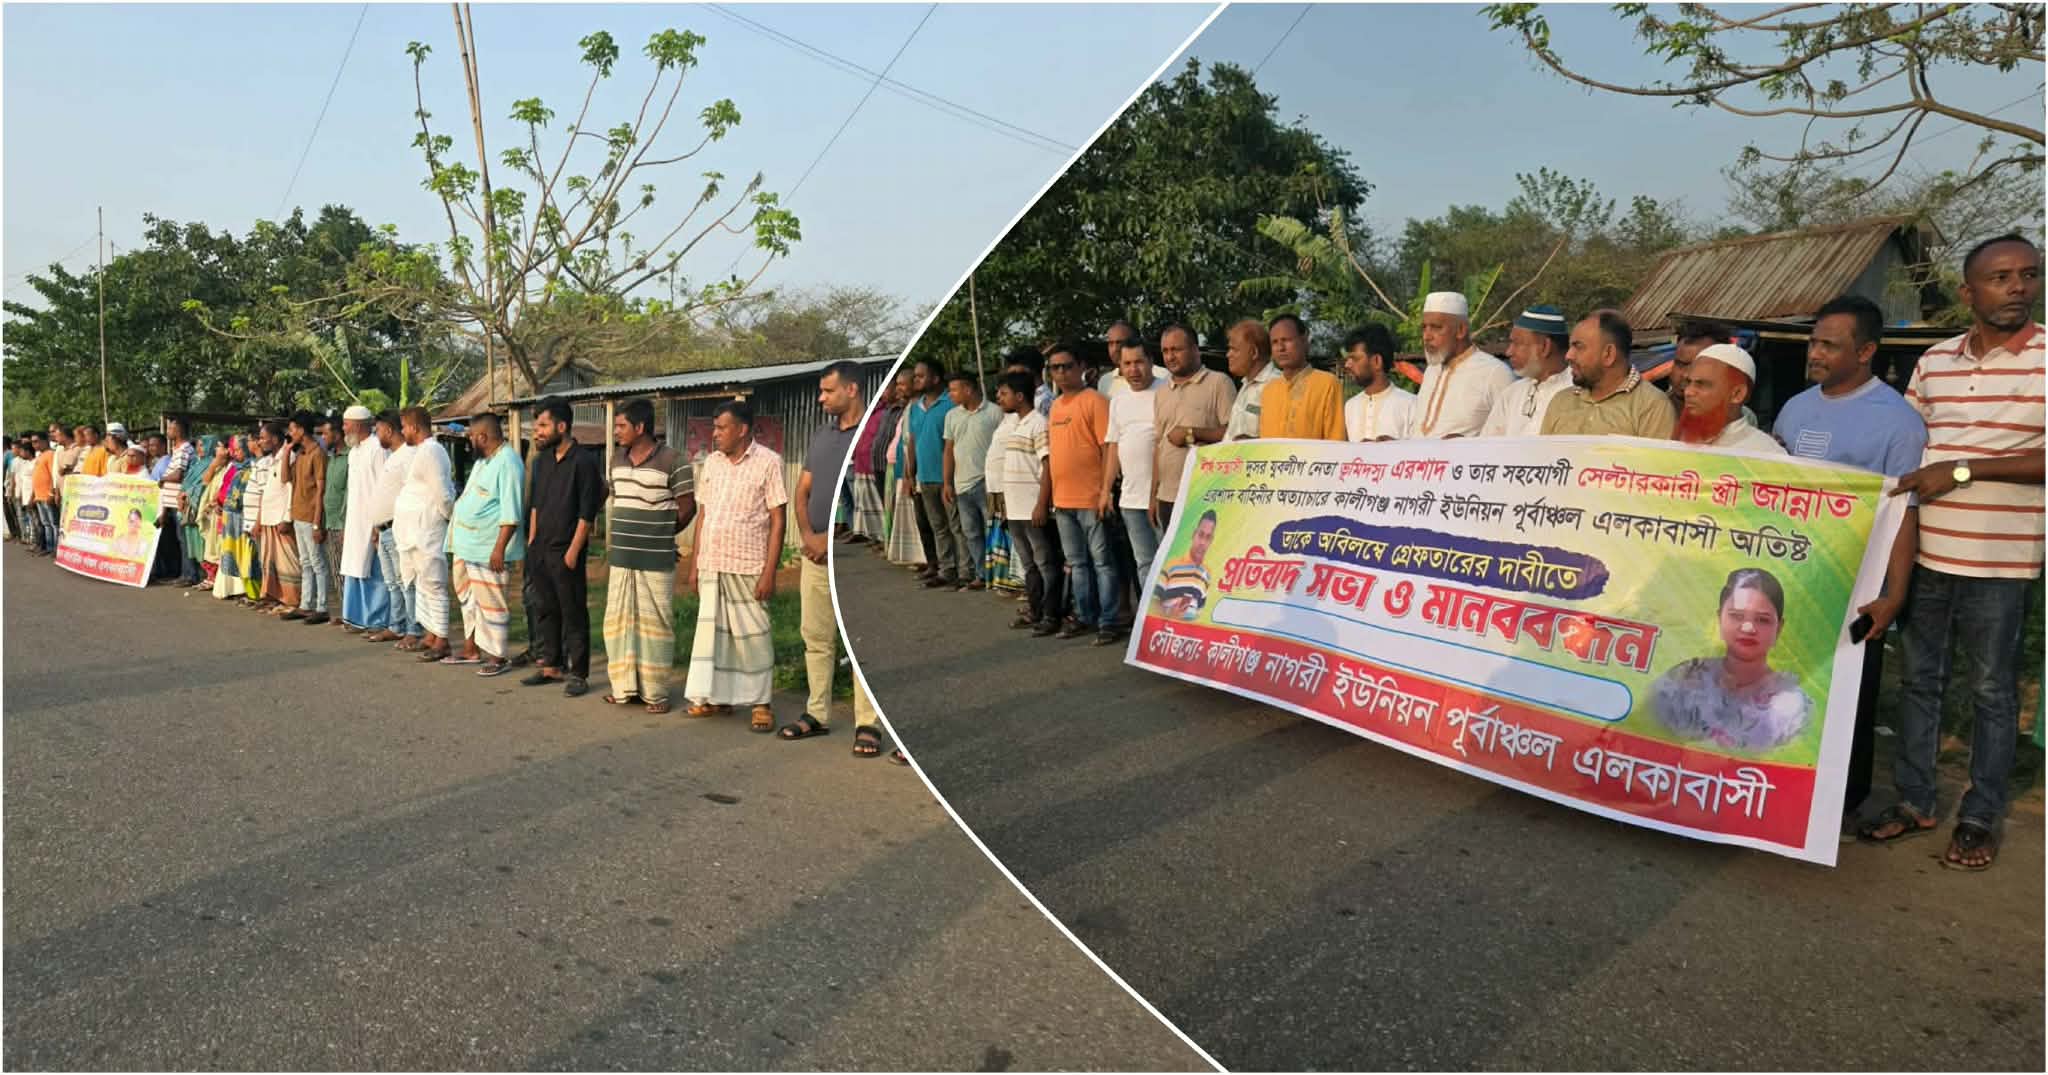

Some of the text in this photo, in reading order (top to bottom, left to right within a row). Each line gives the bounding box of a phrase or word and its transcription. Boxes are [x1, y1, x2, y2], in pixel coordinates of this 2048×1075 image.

[1238, 484, 1275, 506] বাহিনীর
[1277, 489, 1331, 507] অত্যাচারে
[1334, 487, 1391, 514] কালীগঞ্জ
[1393, 490, 1438, 517] নাগরী
[1439, 494, 1507, 523] ইউনিয়ন
[1513, 497, 1586, 533] পূর্বাঞ্চল
[1593, 511, 1722, 550] এলকাবাসী
[1270, 455, 1306, 478] যুবলীগ
[1308, 461, 1339, 476] নেতা
[1391, 459, 1448, 481] এরশাদ
[1452, 465, 1464, 480] ও
[1469, 464, 1498, 483] তার
[1502, 458, 1573, 487] সহযোগী
[1578, 464, 1702, 501] সেল্টারকারী
[1712, 474, 1743, 507] স্ত্রী
[1752, 482, 1858, 522] জান্নাত
[1282, 528, 1583, 590] তাকে অবিলম্বে গ্রেফতারের দাবীতে
[1218, 545, 1662, 673] প্রতিবাদ সভা ও মানববন্ধন
[1206, 634, 1263, 675] কালীগঞ্জ
[1264, 651, 1328, 695] নাগরী
[1332, 662, 1440, 734] ইউনিয়ন
[1446, 695, 1564, 771] পূর্বাঞ্চল
[1573, 747, 1776, 819] এলকাবাসী
